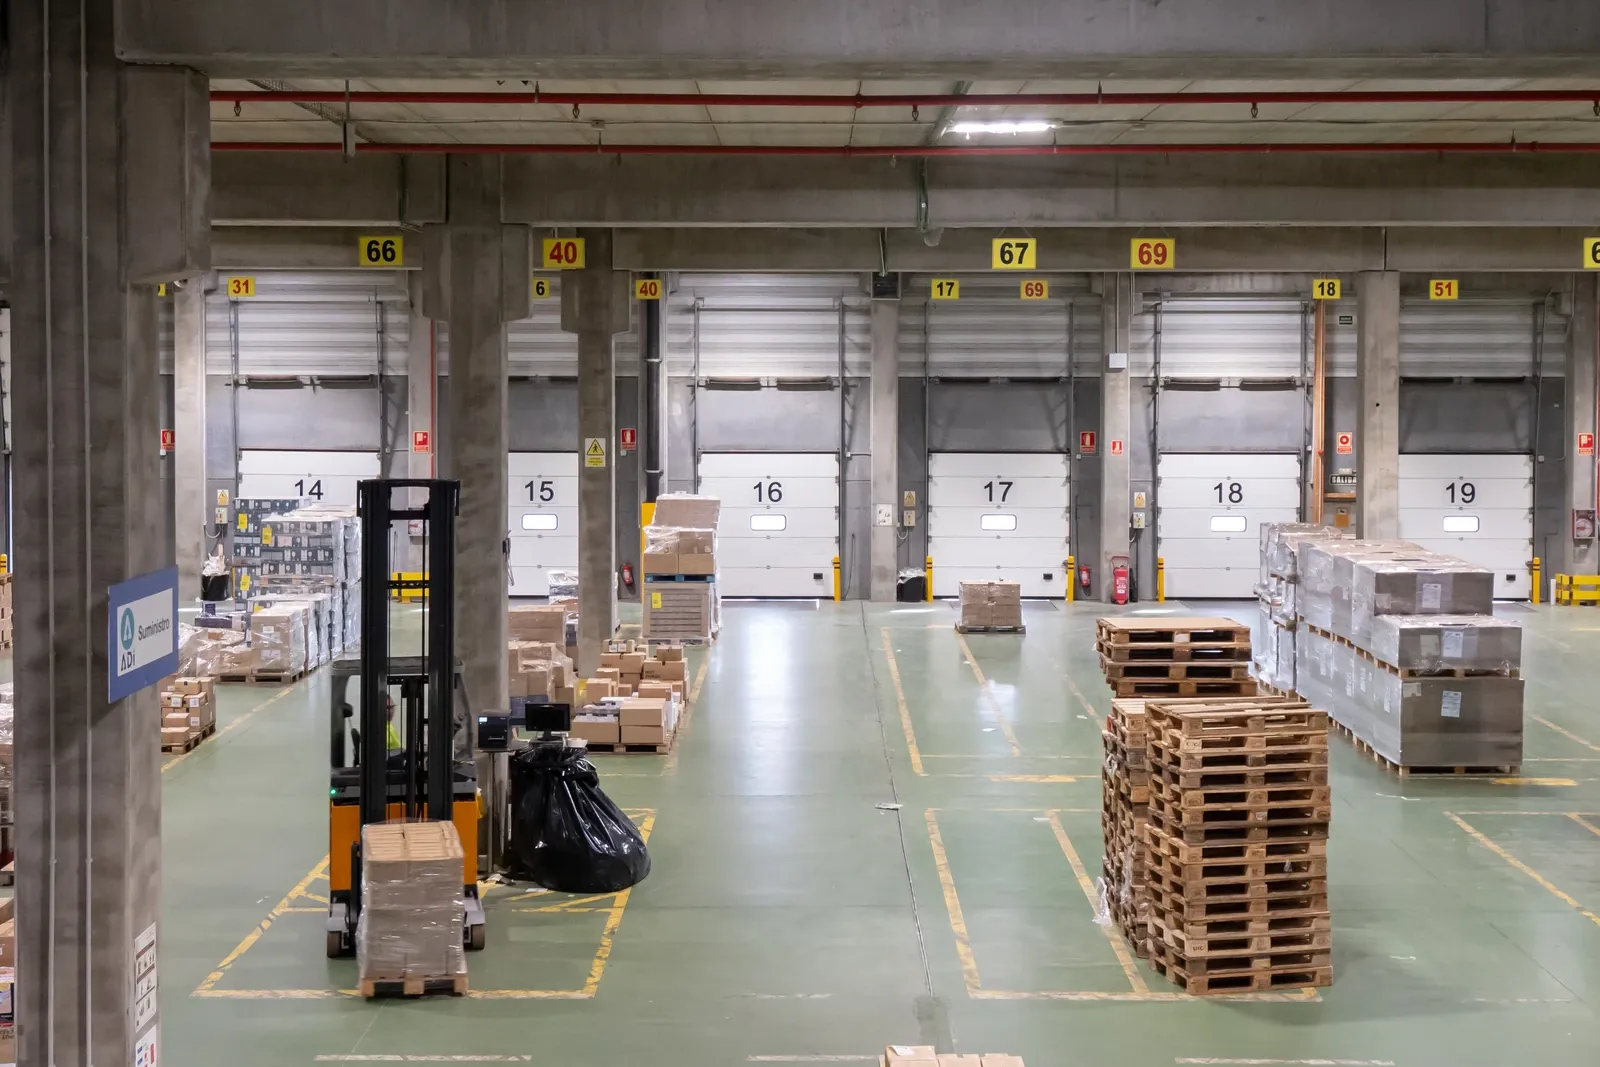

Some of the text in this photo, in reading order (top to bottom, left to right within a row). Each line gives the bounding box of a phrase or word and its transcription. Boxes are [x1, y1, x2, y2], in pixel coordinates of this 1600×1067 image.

[366, 240, 396, 262] 66
[548, 241, 578, 264] 40
[999, 242, 1028, 264] 67
[1138, 242, 1167, 264] 69
[1591, 241, 1600, 263] 6
[232, 280, 248, 295] 31
[535, 281, 545, 296] 6
[639, 282, 658, 297] 40
[936, 282, 954, 297] 17
[1025, 282, 1044, 297] 69
[1317, 282, 1336, 297] 18
[1434, 282, 1452, 297] 51
[294, 480, 323, 502] 14
[525, 480, 554, 502] 15
[1331, 476, 1357, 484] SALIDA
[754, 481, 783, 503] 16
[984, 481, 1013, 503] 17
[1214, 482, 1243, 504] 18
[1446, 482, 1475, 504] 19
[138, 617, 170, 641] Suministro
